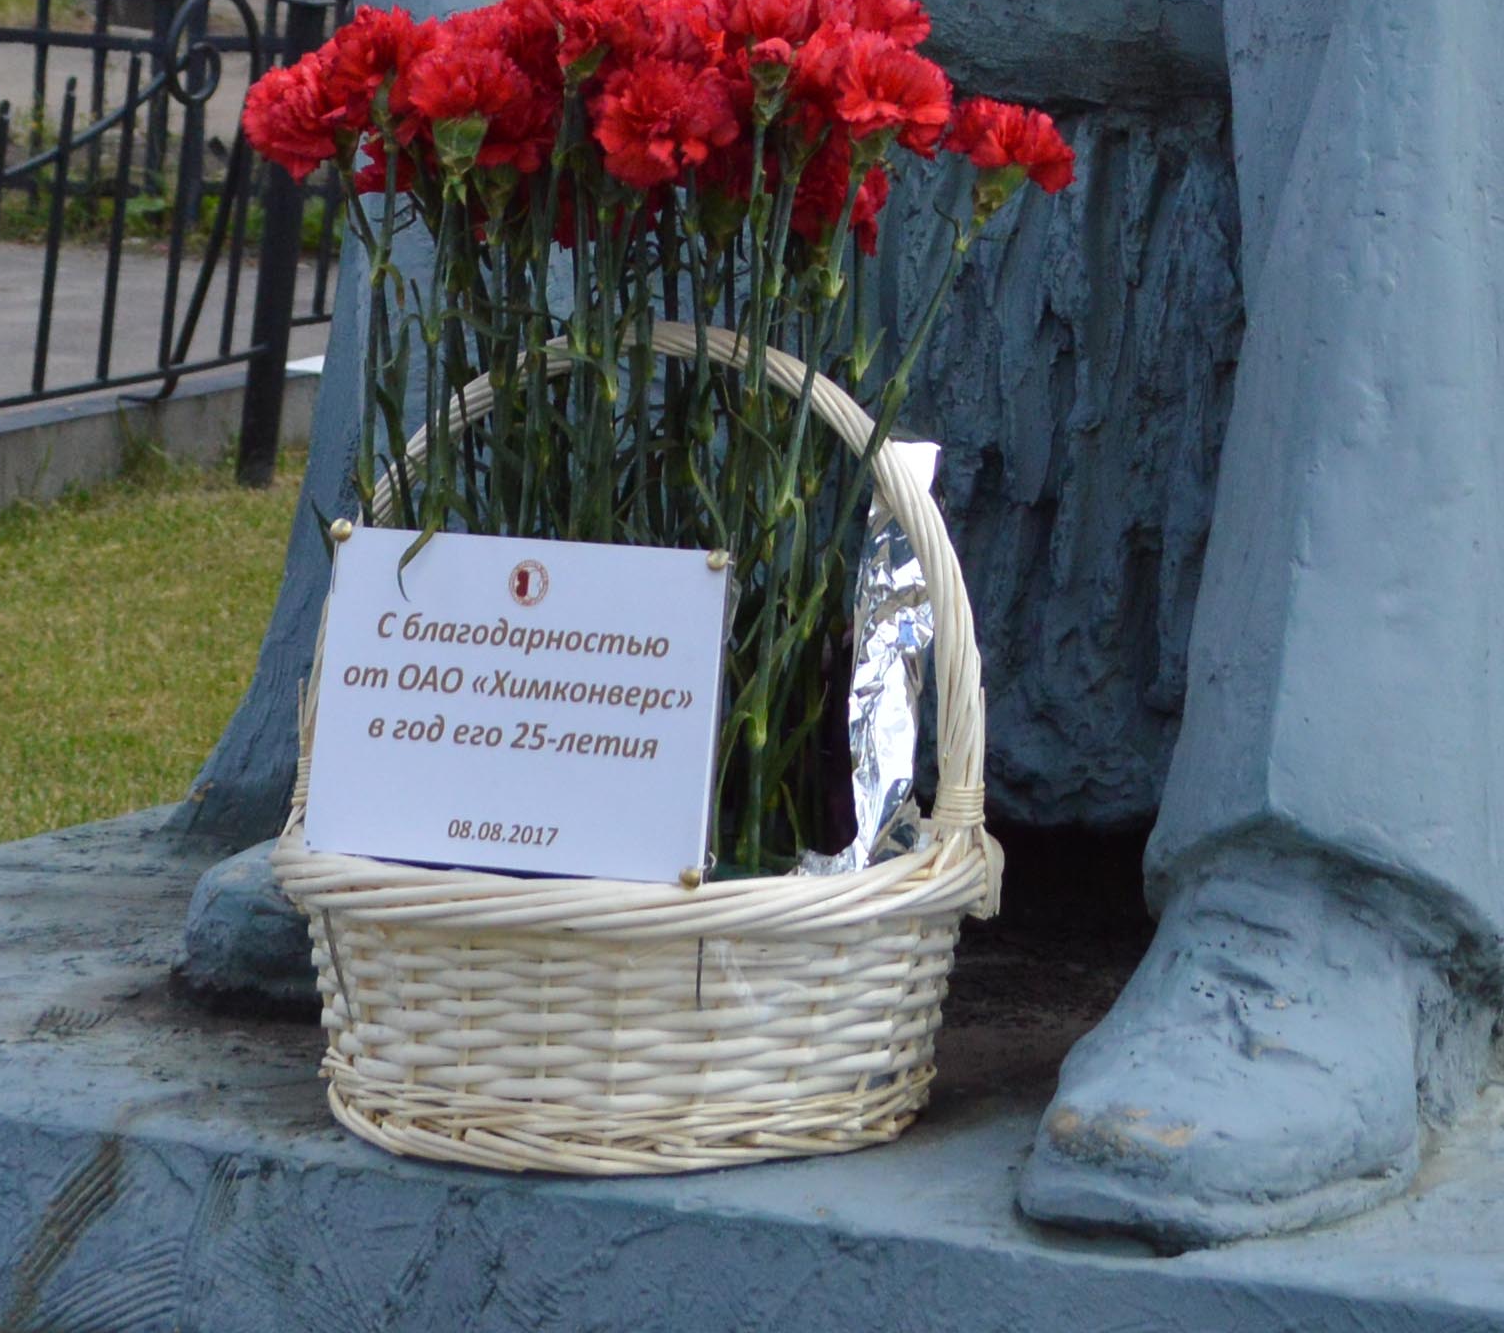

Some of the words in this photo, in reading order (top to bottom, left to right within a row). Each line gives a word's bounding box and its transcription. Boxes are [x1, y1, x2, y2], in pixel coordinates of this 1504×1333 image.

[377, 611, 397, 638] С
[402, 612, 669, 658] благодарностью
[343, 665, 389, 689] от
[397, 664, 464, 694] ОАО
[472, 669, 693, 715] «Химконверс»
[368, 717, 385, 738] в
[392, 713, 445, 743] год
[453, 724, 503, 747] его
[510, 722, 659, 760] 25-летия
[447, 819, 559, 846] 08.08.2017
